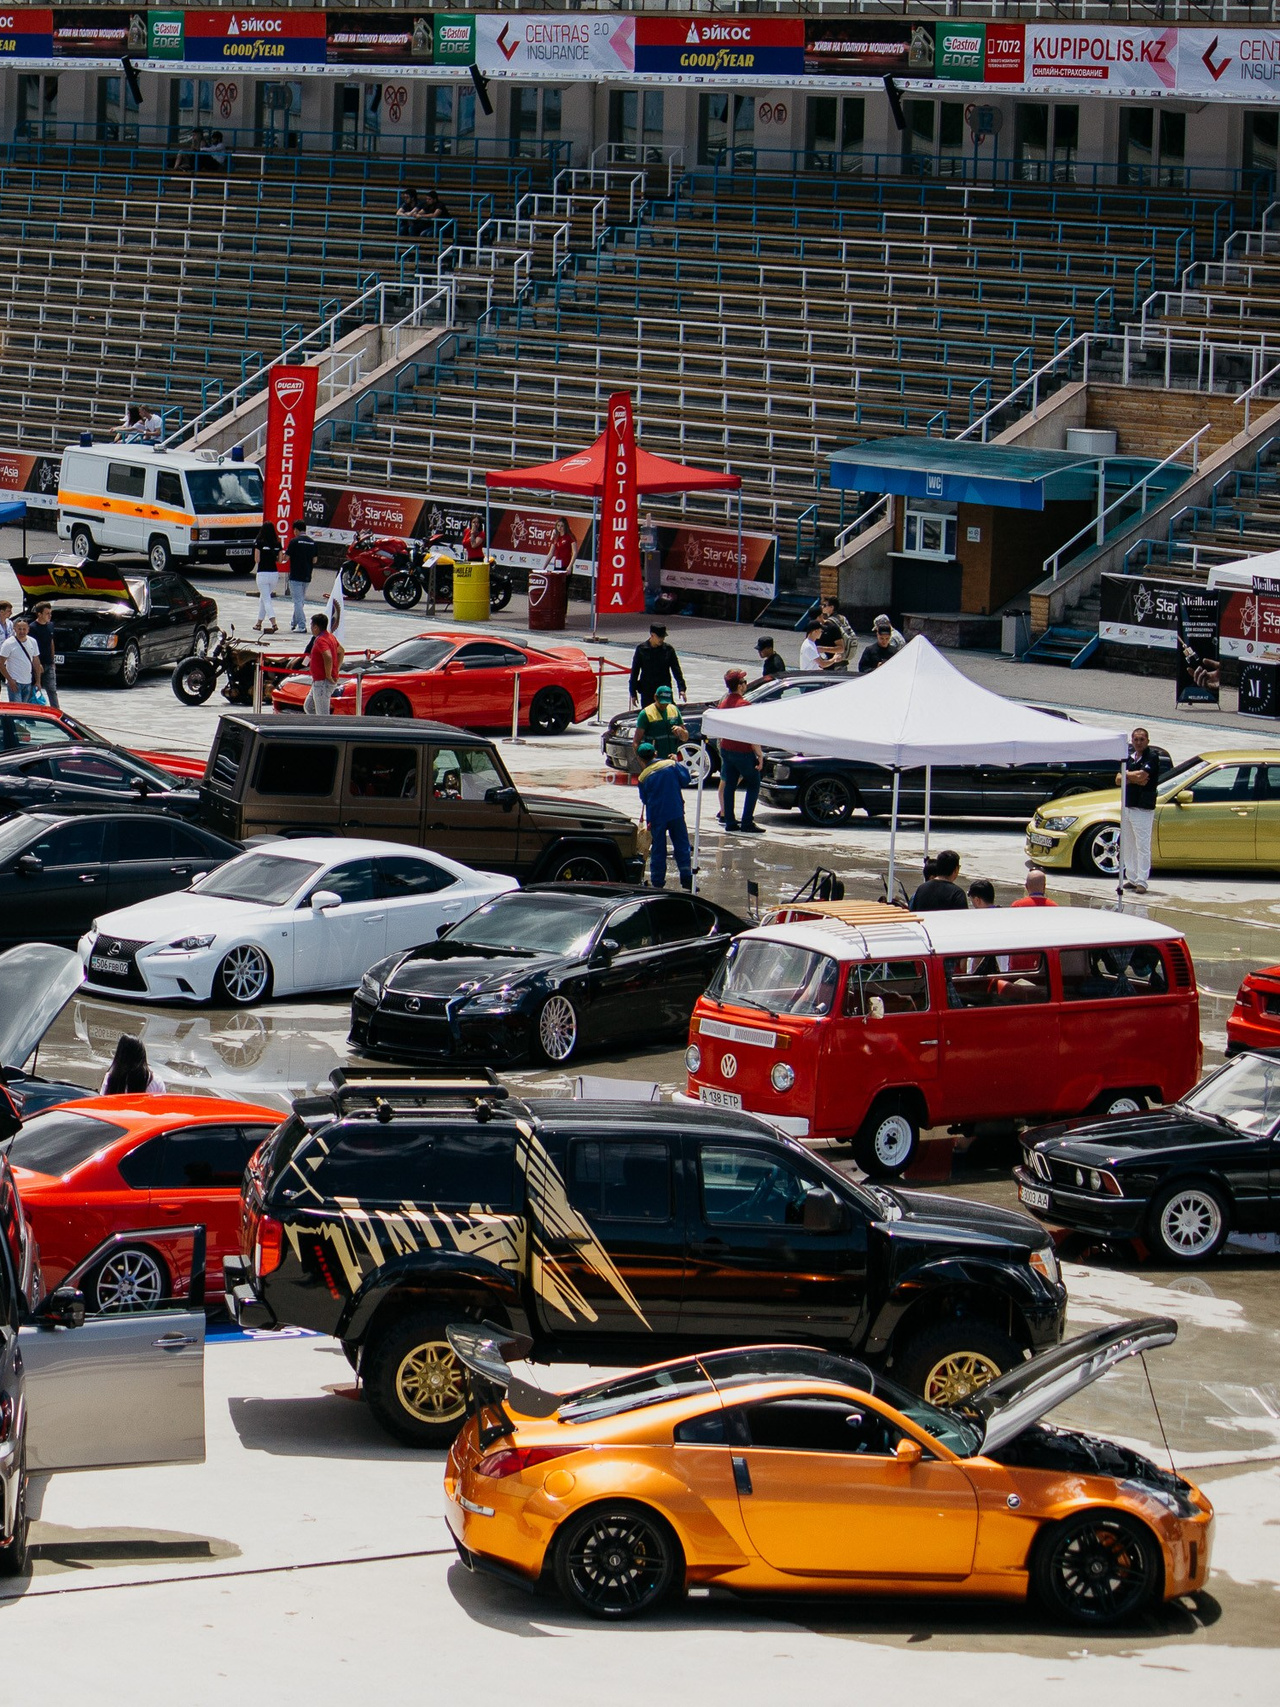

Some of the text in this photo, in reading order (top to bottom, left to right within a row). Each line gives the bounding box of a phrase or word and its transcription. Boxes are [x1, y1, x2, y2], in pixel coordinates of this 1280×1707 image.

[159, 24, 179, 34] Castrol
[241, 17, 282, 32] ЭЙКОС
[446, 28, 469, 40] Castrol
[525, 23, 609, 43] CENTRAS 2.0
[702, 24, 751, 40] ЭЙКОС
[153, 37, 181, 48] EDGE
[439, 42, 471, 53] EDGE
[951, 39, 978, 51] Castrol
[996, 40, 1020, 53] 7072
[223, 42, 285, 58] GOODYEAR
[527, 45, 589, 60] INSURANCE
[1033, 37, 1167, 63] KUPIPOLIS.KZ
[680, 51, 755, 69] GOODYEAR
[942, 54, 980, 67] EDGE
[1033, 67, 1103, 77] ОНЛАЙН-СТРАХОВАНИЕ
[3, 467, 19, 478] Asia
[928, 475, 942, 489] WC
[306, 500, 324, 513] Asia
[365, 507, 381, 520] Star
[385, 509, 404, 523] Asia
[445, 516, 462, 530] Star
[610, 442, 632, 606] МОТОШКОЛА
[528, 527, 546, 540] Star
[703, 546, 722, 561] Star
[726, 550, 747, 564] Asa
[1156, 598, 1179, 613] Star
[1181, 596, 1219, 607] Meilleur
[1263, 611, 1280, 626] Sta
[702, 1089, 739, 1107] A 138 ETP
